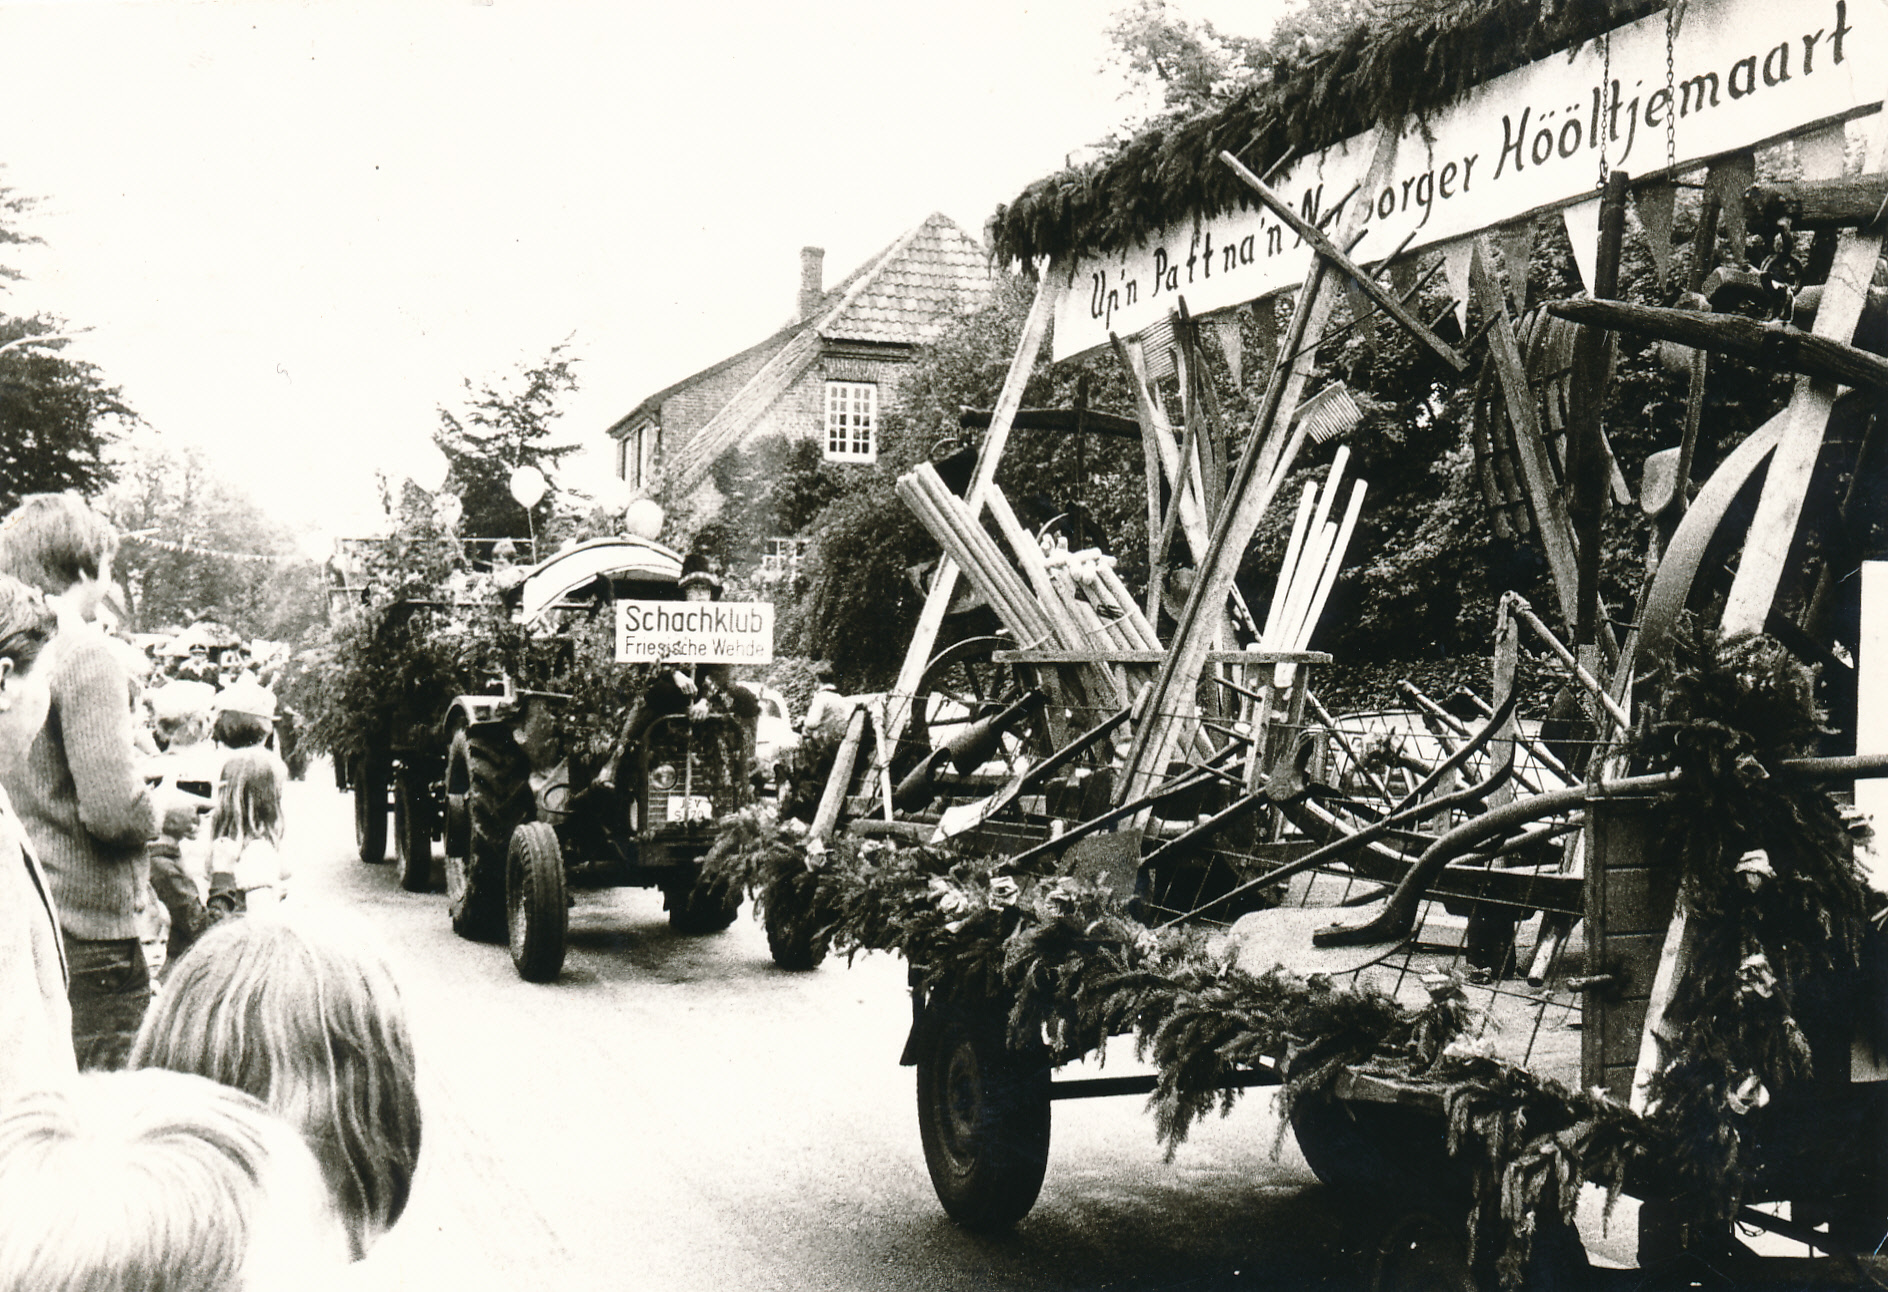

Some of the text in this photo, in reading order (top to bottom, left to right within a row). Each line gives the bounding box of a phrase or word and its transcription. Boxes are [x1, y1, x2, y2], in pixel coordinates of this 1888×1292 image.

[1091, 269, 1137, 330] Up'n
[1492, 0, 1854, 181] Hööltjemaart
[625, 605, 763, 633] Schachklub
[625, 635, 765, 657] Friesische Wehde
